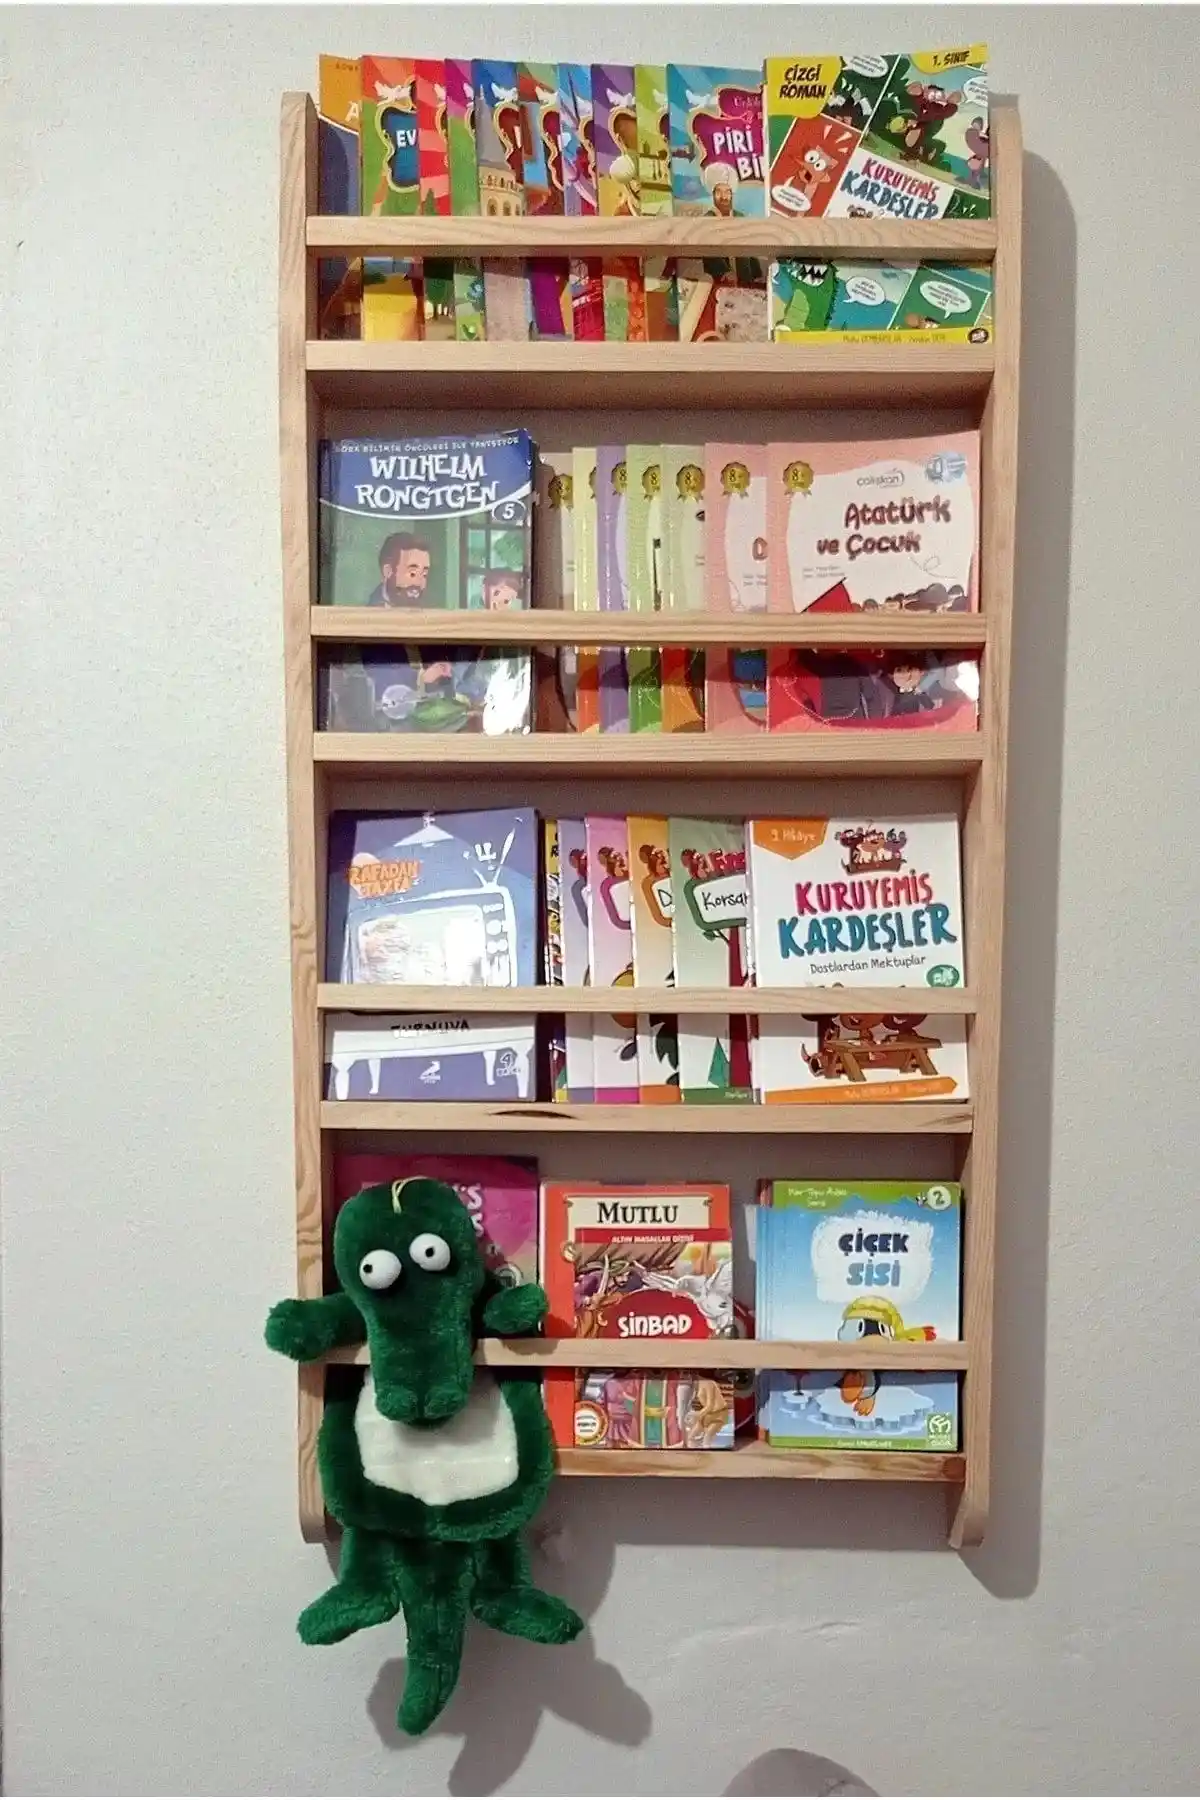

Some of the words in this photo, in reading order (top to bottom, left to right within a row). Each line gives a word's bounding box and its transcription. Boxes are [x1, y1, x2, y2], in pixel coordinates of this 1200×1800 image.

[784, 64, 822, 84] ÇİZGİ
[779, 84, 827, 98] ROMAN
[713, 124, 753, 155] PİRİ
[369, 453, 487, 481] WILHELM
[354, 481, 499, 511] RONGTGEN
[503, 503, 515, 519] 5
[845, 495, 951, 530] Atatürk
[817, 538, 839, 555] ve
[846, 531, 921, 561] Çocuk
[795, 869, 933, 916] KURUYEMİŞ
[778, 902, 957, 959] KARDEŞLER
[810, 961, 868, 975] Dostlardan
[871, 954, 926, 970] Mektuplar
[933, 1190, 945, 1205] 2
[597, 1202, 679, 1224] MUTLU
[838, 1228, 909, 1257] ÇİÇEK
